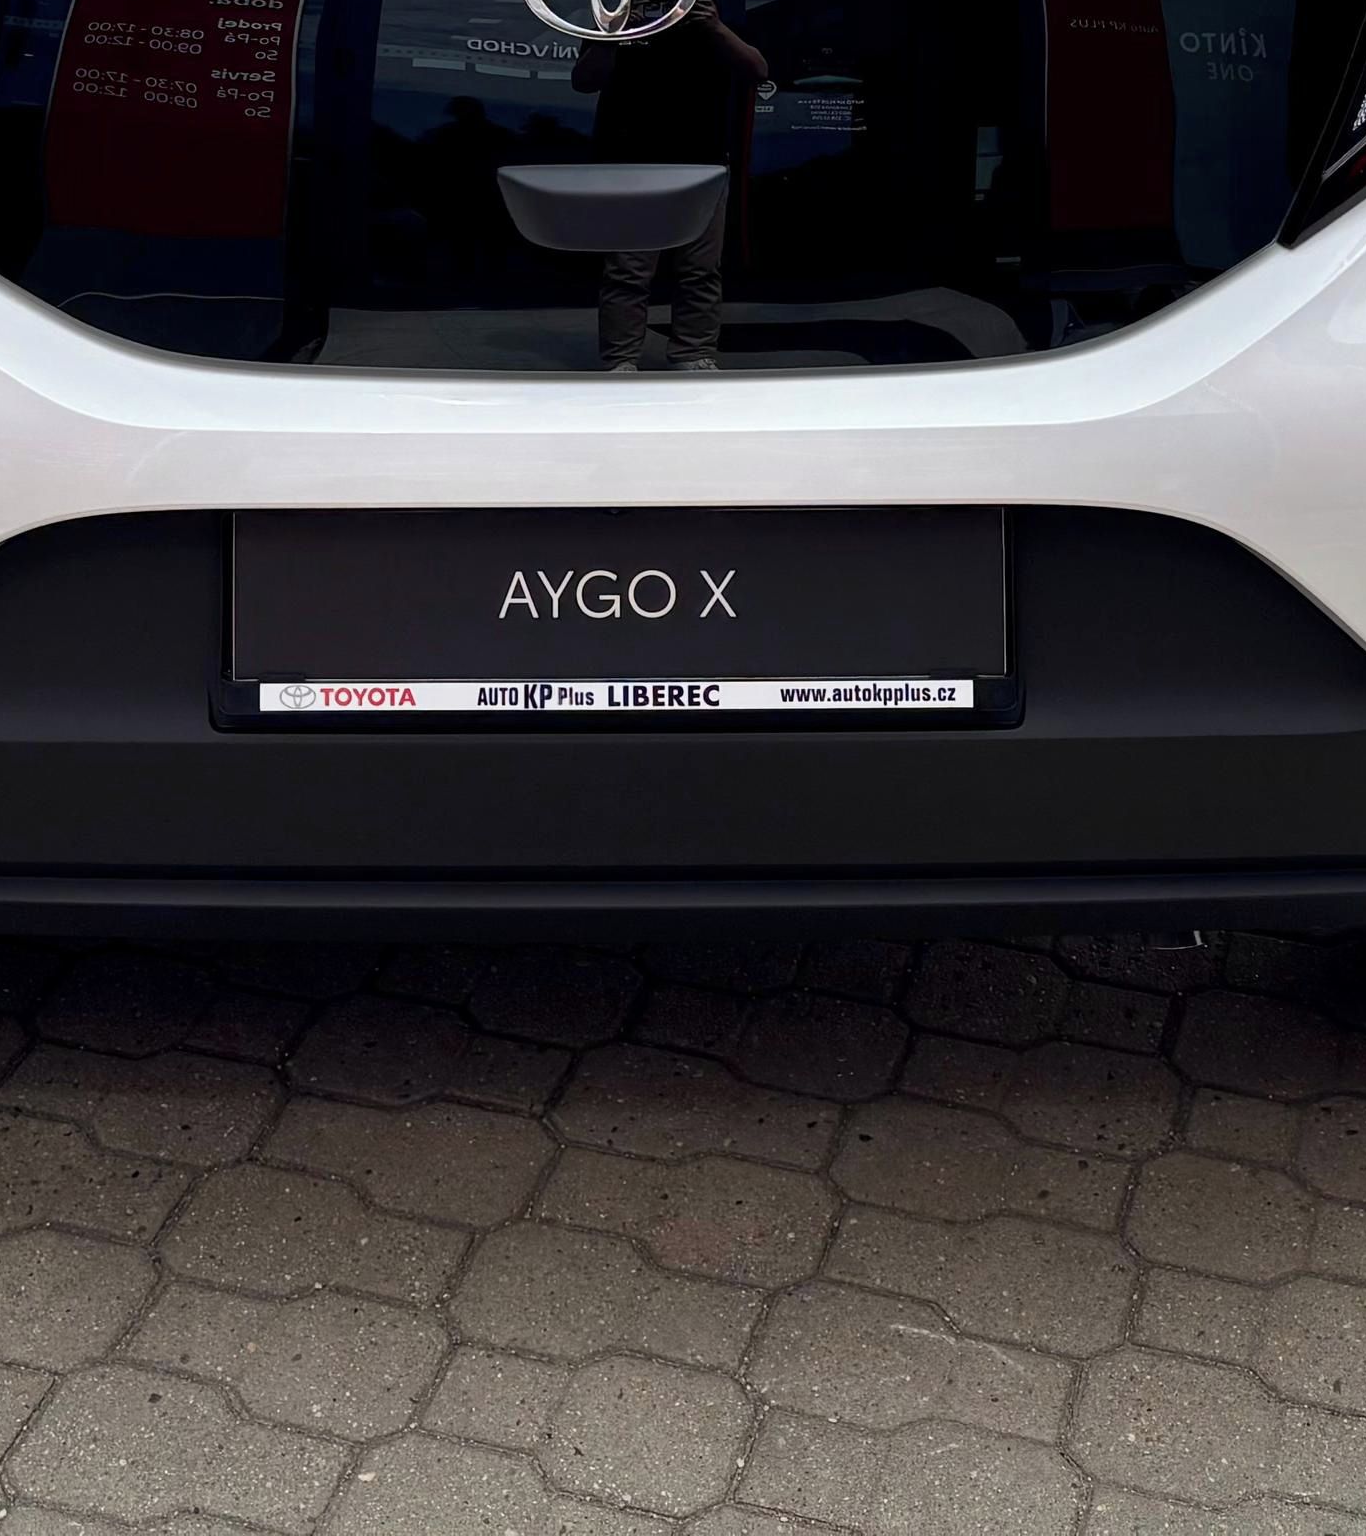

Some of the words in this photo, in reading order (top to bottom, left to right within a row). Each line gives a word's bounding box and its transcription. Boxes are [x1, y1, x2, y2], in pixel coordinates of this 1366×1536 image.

[499, 569, 677, 619] AYGO
[699, 569, 737, 618] X
[320, 687, 417, 706] TOYOTA
[477, 687, 519, 706] AUTO
[523, 684, 553, 709] KP
[558, 687, 595, 706] Plus
[607, 684, 720, 707] LIBEREC
[780, 683, 957, 706] www.autokpplus.cz
